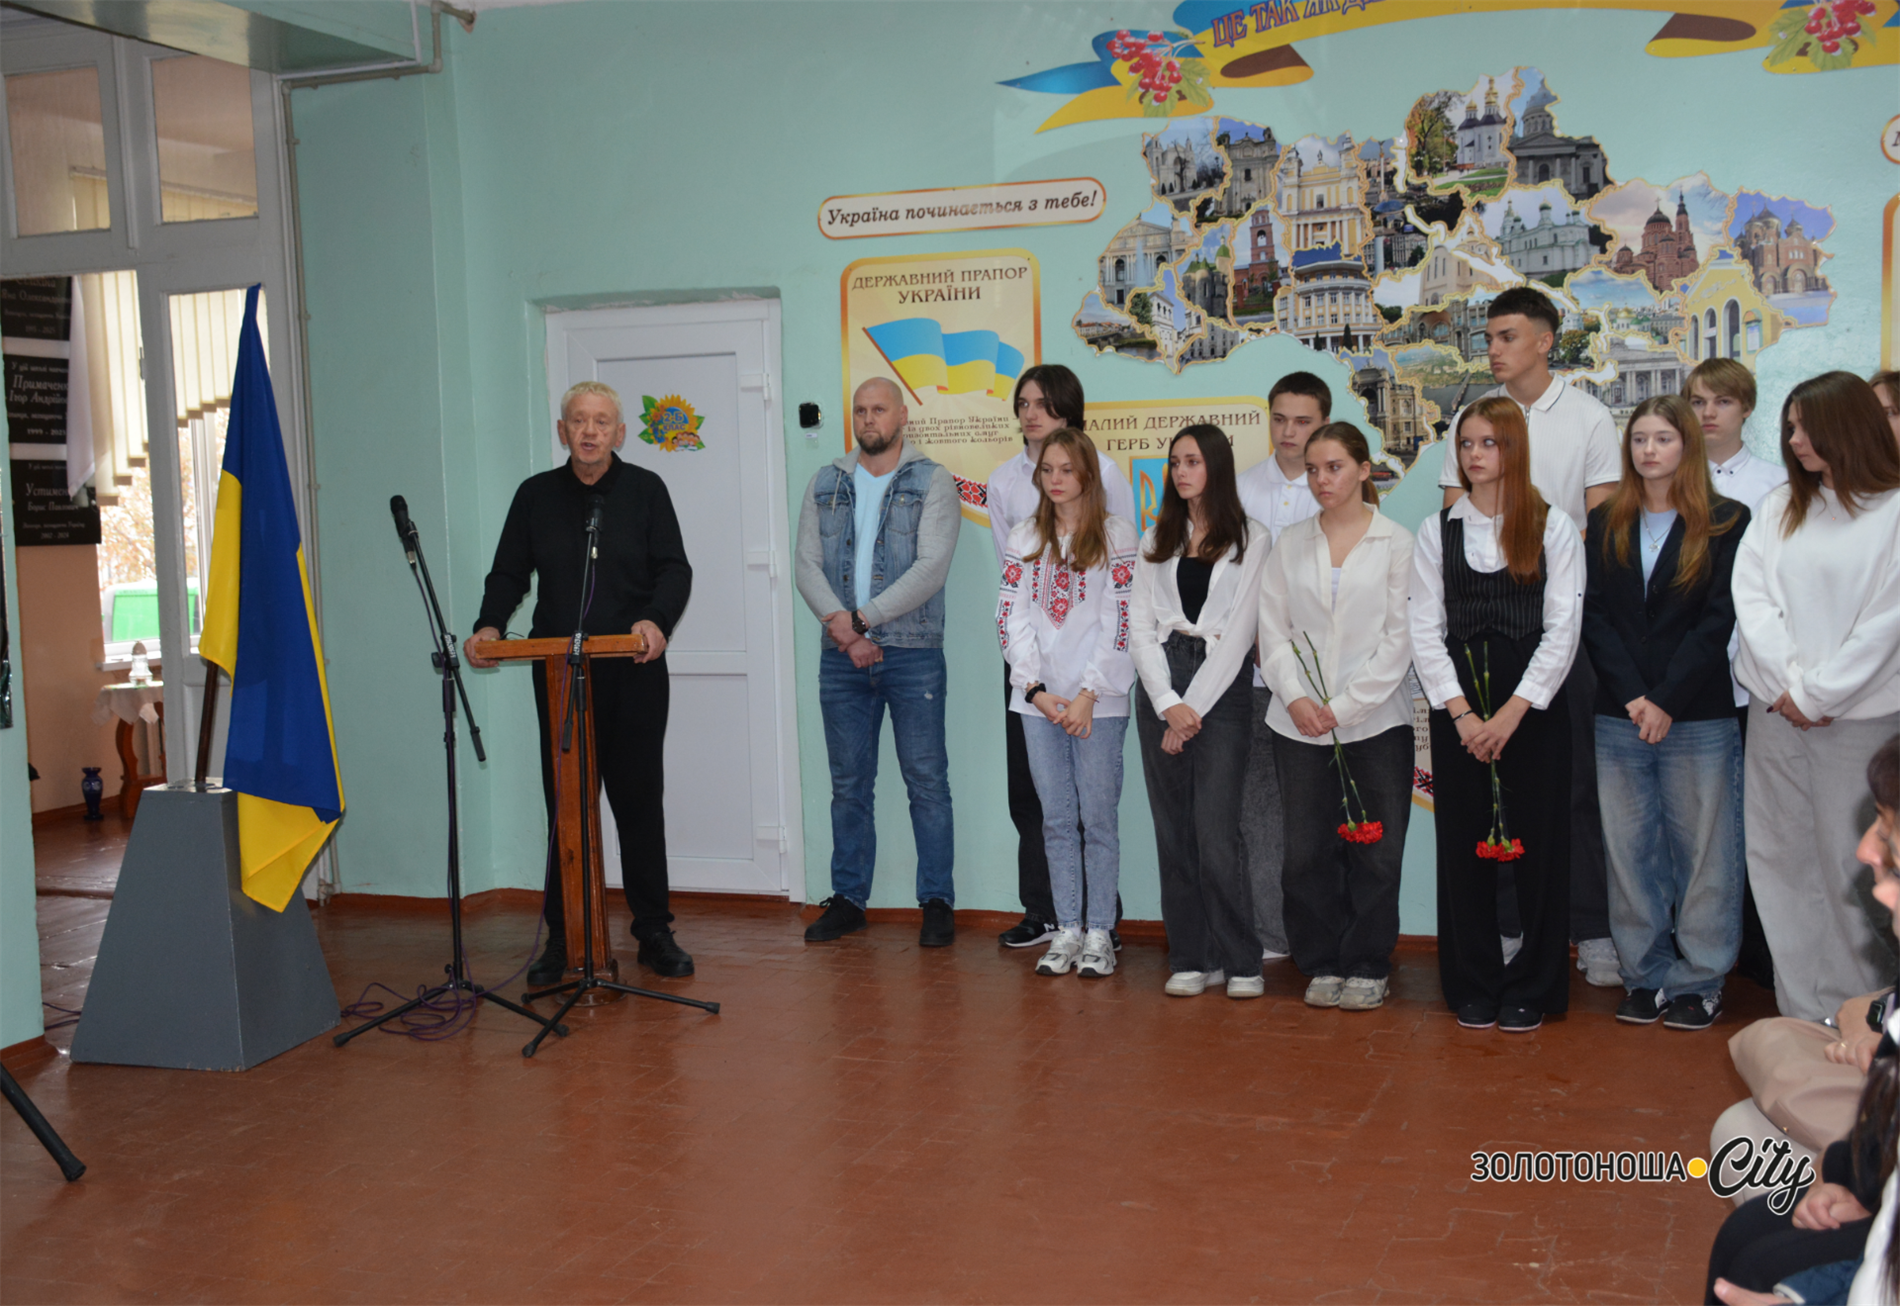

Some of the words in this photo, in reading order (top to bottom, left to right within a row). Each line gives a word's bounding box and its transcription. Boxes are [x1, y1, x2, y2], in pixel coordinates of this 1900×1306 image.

[1211, 9, 1248, 48] ЦЕ
[1250, 0, 1300, 33] ТАК
[827, 207, 900, 227] Україна
[905, 200, 1023, 221] починається
[1028, 199, 1038, 211] з
[1045, 190, 1098, 211] тебе!
[852, 269, 955, 291] ДЕРЖАВНИЙ
[961, 267, 1028, 283] ПРАПОР
[898, 286, 981, 305] УКРАЇНИ
[663, 411, 684, 424] 2-Б
[929, 417, 965, 426] Прапор
[968, 415, 1009, 424] України
[1143, 410, 1261, 431] ДЕРЖАВНИЙ
[662, 423, 686, 432] КЛАС
[919, 425, 940, 433] двох
[944, 423, 1010, 432] рівновеликих
[925, 437, 967, 445] жовтого
[970, 436, 1013, 444] кольорів
[1107, 438, 1150, 451] ГЕРБ
